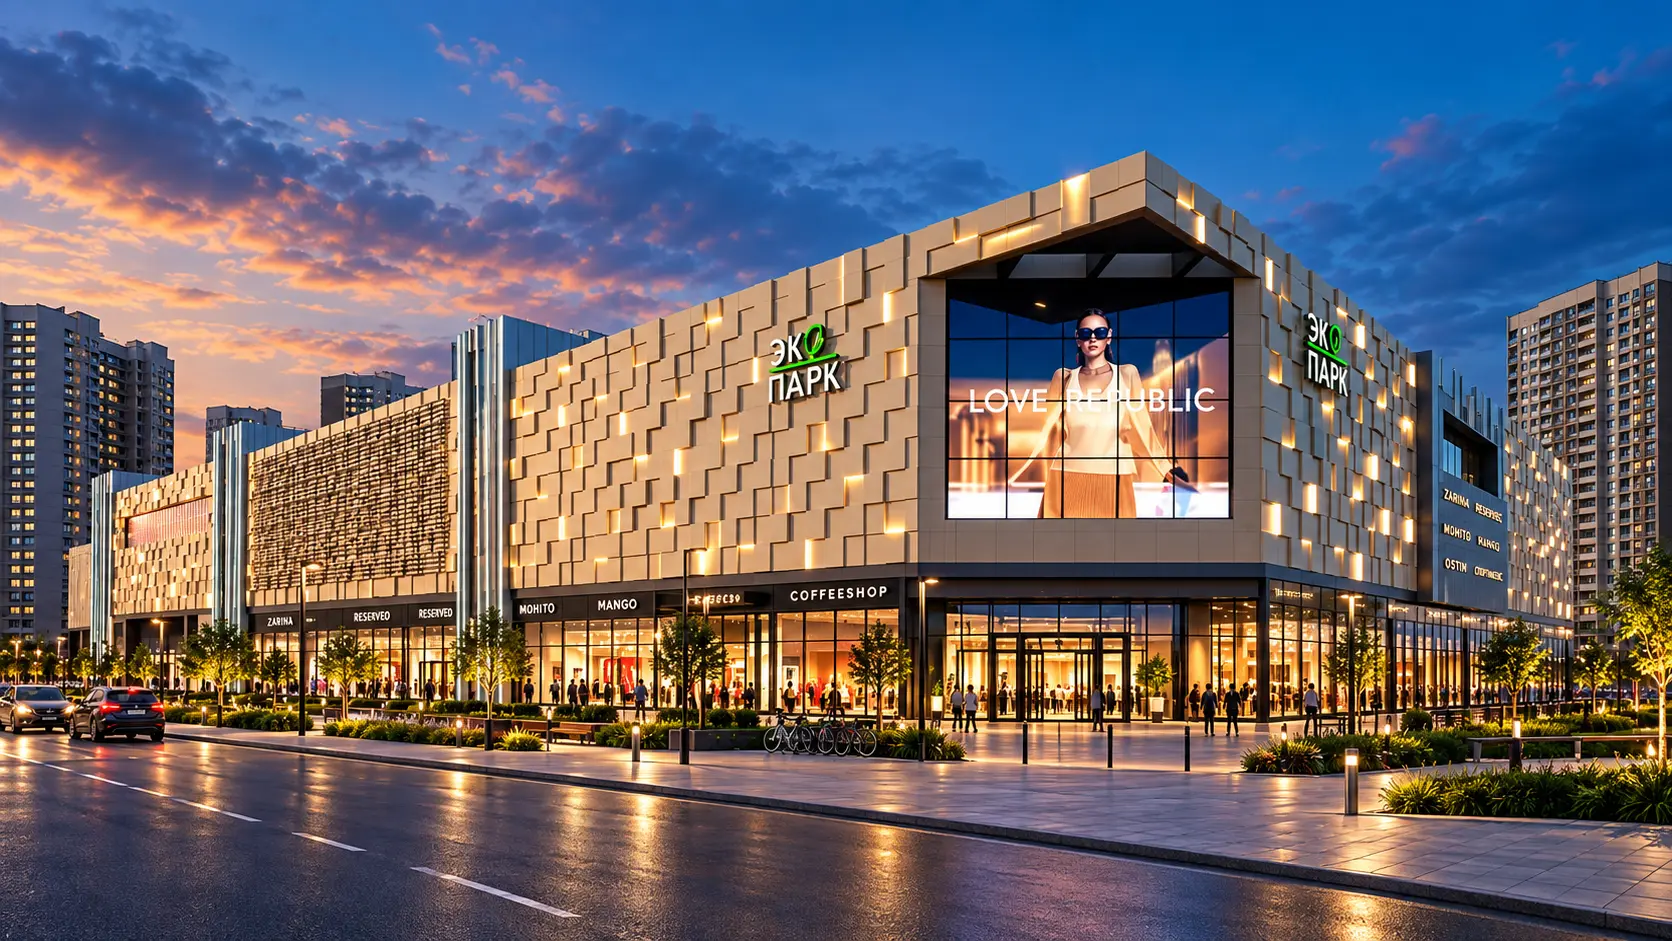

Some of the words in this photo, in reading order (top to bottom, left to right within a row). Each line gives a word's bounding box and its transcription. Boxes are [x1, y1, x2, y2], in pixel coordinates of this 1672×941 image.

[770, 324, 824, 367] ЭКО
[1308, 313, 1342, 354] ЭКО
[769, 361, 841, 404] ПАРК
[1308, 349, 1348, 397] ПАРК
[969, 389, 1048, 413] LOVE
[1066, 387, 1215, 413] REPUBLIC
[519, 602, 555, 615] MOHITO
[597, 598, 637, 611] MANGO
[790, 586, 887, 602] COFFEESHOP
